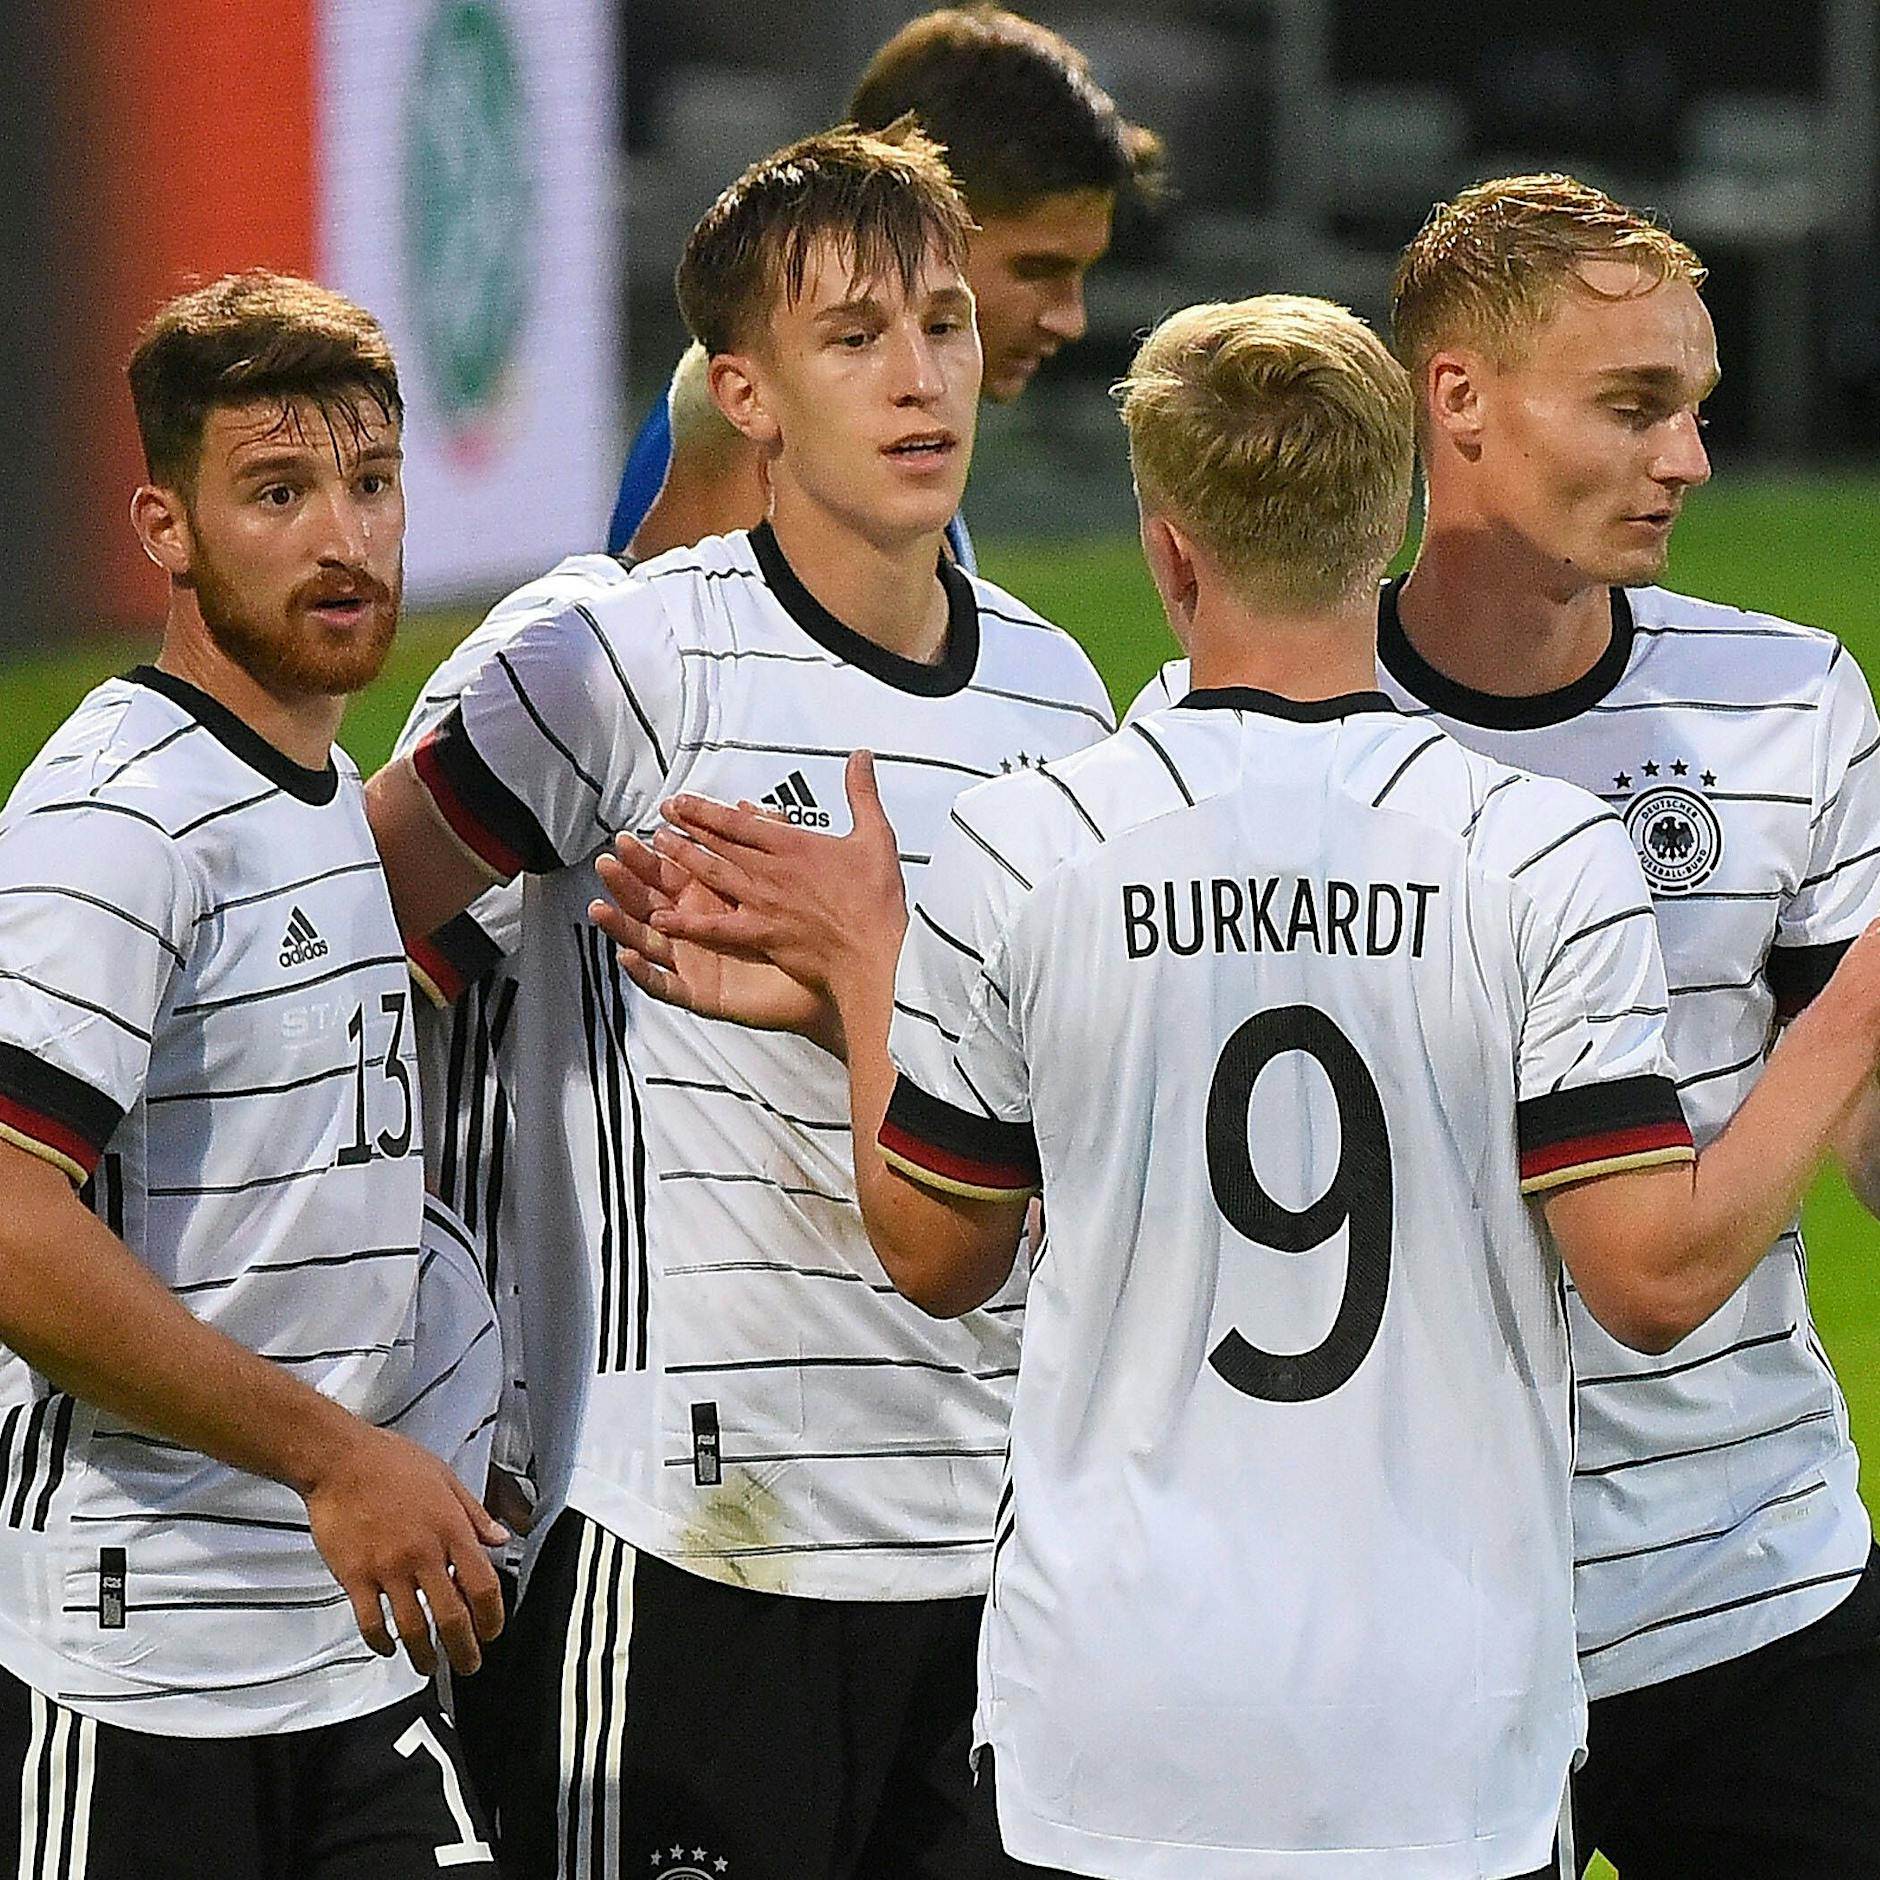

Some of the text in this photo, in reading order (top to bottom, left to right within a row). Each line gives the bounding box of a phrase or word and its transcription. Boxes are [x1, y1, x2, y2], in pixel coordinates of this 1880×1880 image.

[1641, 800, 1698, 820] DEUTSCHER
[279, 939, 328, 967] adidas
[1122, 877, 1440, 959] BURKARDT
[336, 993, 412, 1167] 13
[1205, 1003, 1393, 1402] 9
[393, 1712, 494, 1868] 1
